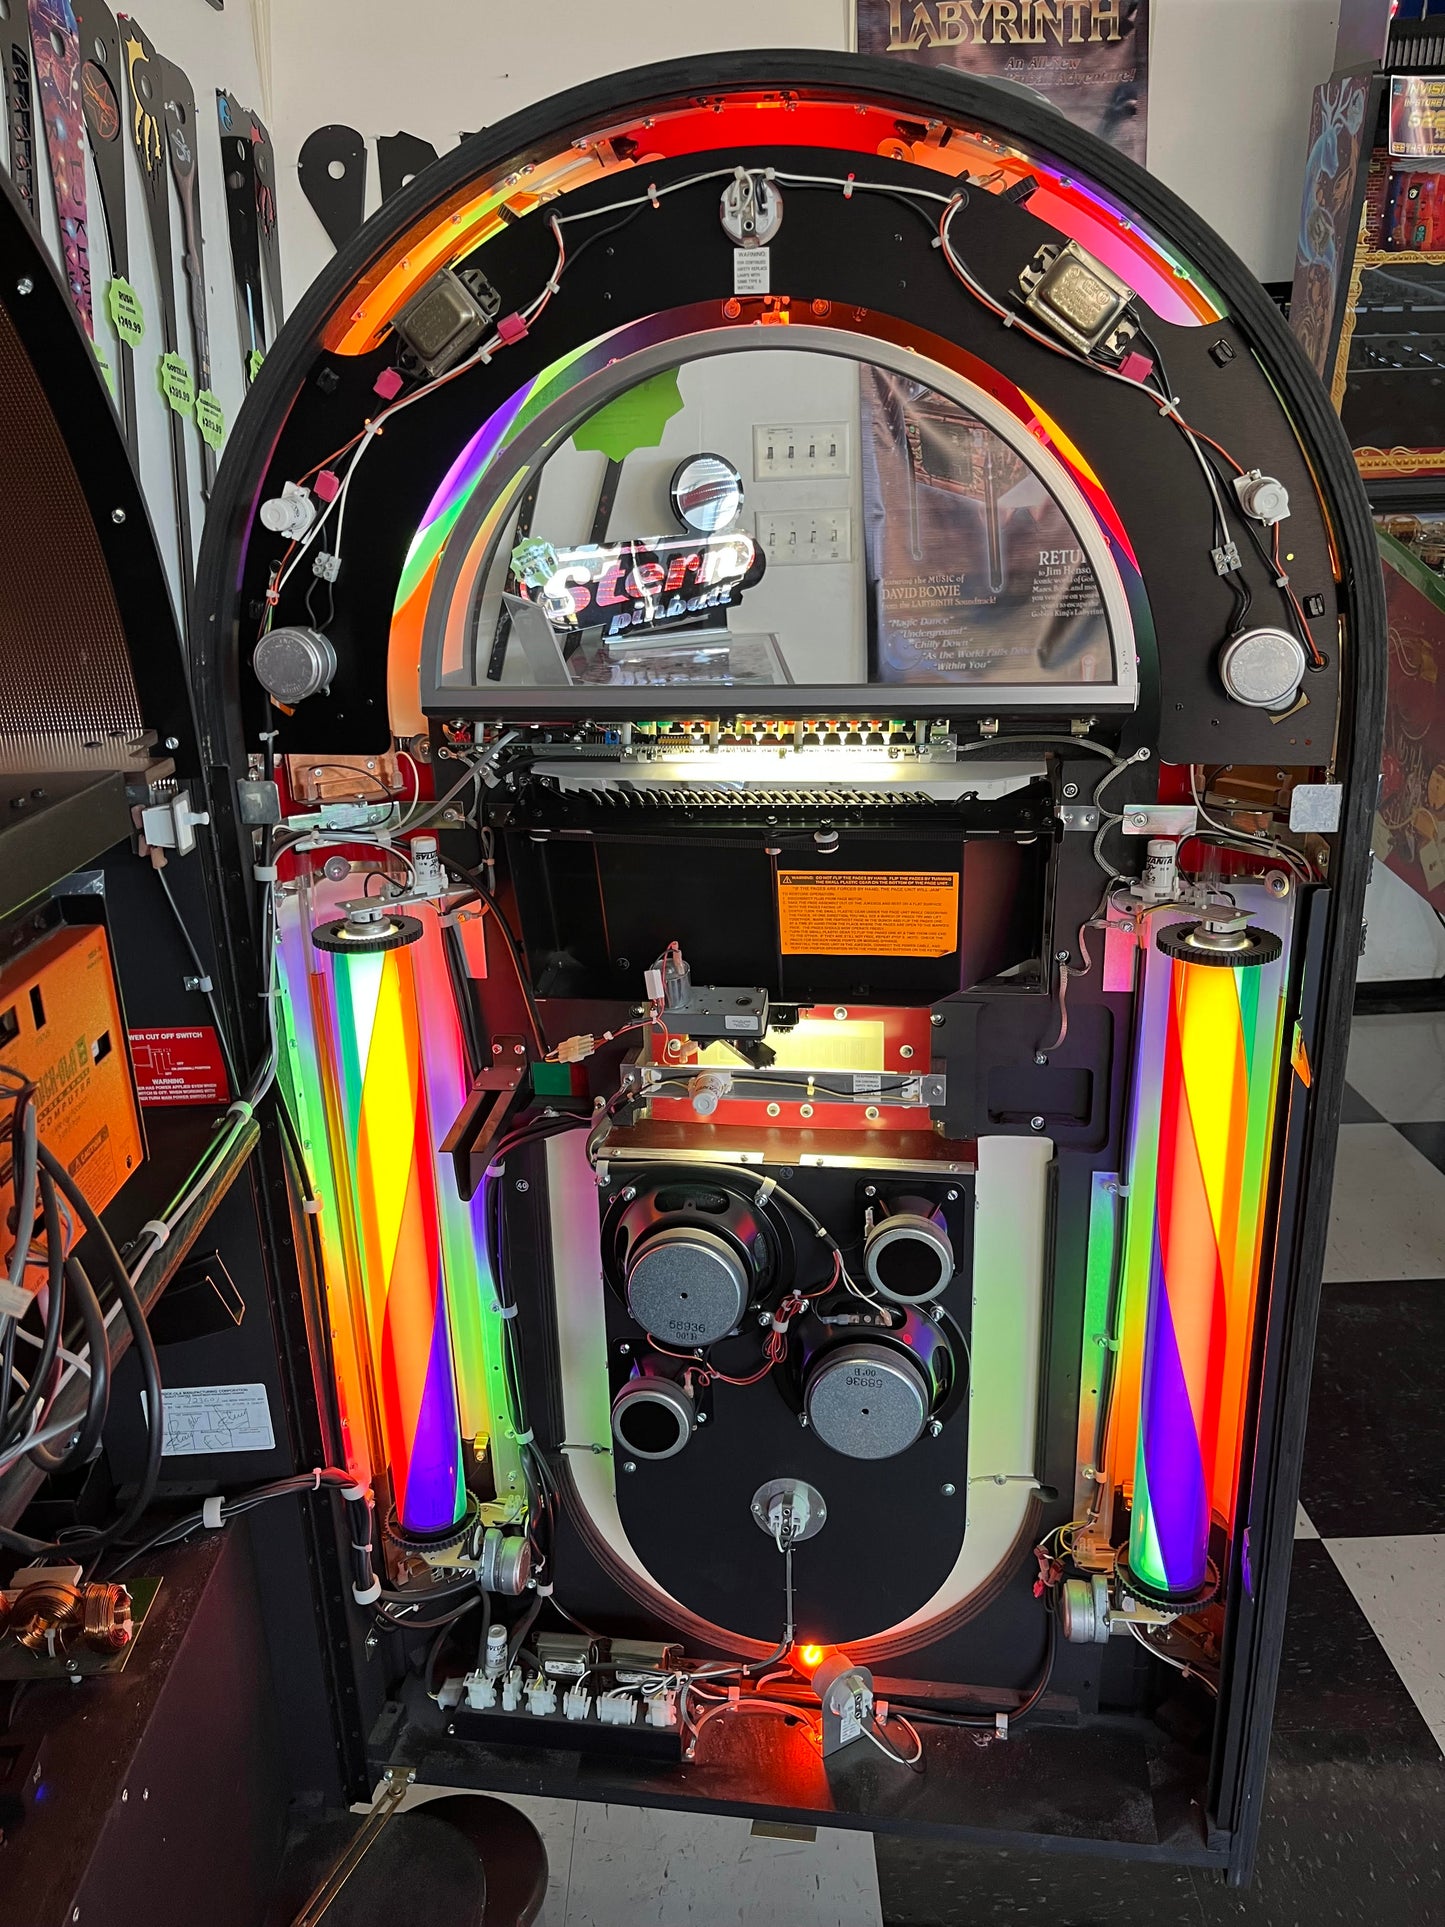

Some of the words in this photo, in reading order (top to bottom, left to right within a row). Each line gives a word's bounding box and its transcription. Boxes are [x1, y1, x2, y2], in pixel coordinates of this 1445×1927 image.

[887, 0, 1122, 51] LABYRINTH
[1005, 57, 1025, 71] An
[1056, 69, 1136, 85] Adventure!
[1046, 565, 1062, 578] Jim
[928, 575, 955, 585] MUSIC
[956, 574, 965, 584] of
[882, 587, 917, 600] DAVID
[918, 585, 961, 599] BOWIE
[911, 598, 954, 609] LABYRINTH
[161, 1032, 175, 1040] OFF
[175, 1031, 203, 1039] SWITCH
[40, 1077, 91, 1133] COMPUTER
